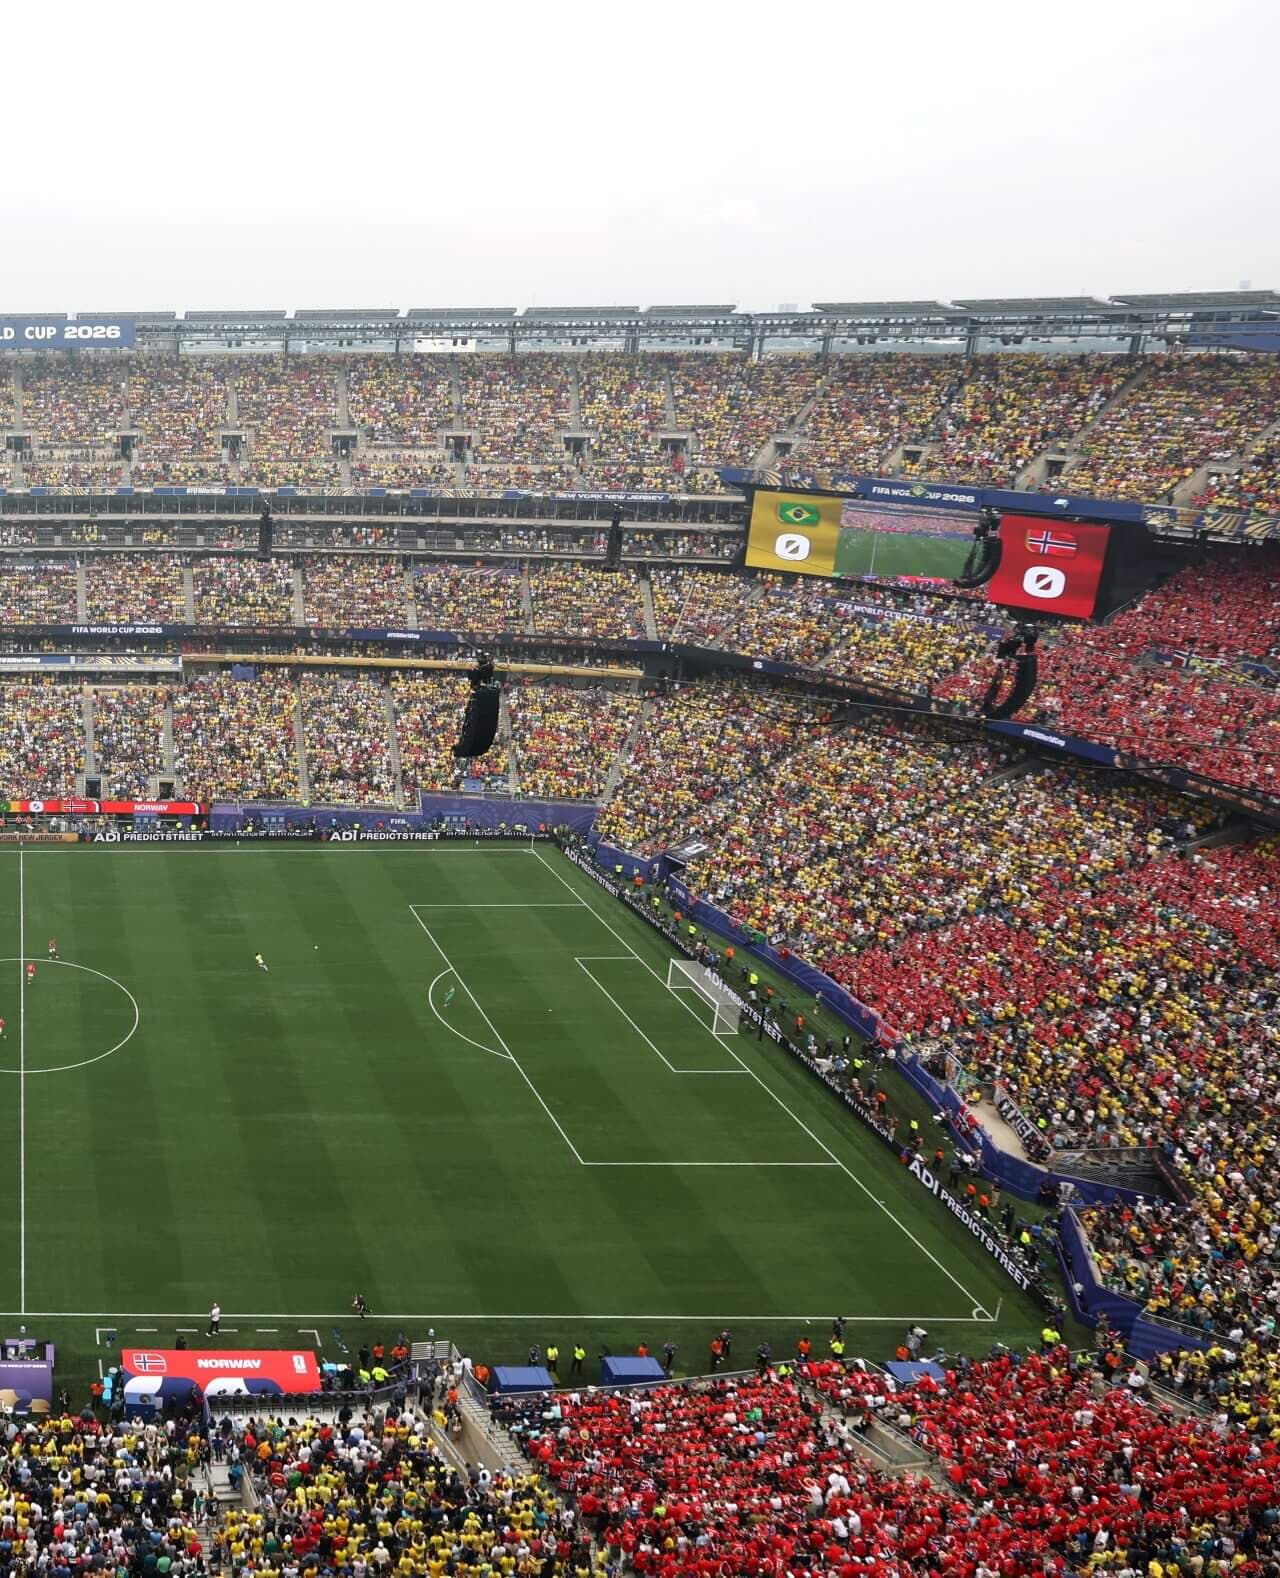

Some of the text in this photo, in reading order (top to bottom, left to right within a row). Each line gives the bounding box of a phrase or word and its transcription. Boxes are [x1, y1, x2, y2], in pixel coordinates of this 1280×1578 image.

[24, 326, 57, 339] CUP
[63, 325, 121, 339] 2026
[872, 486, 890, 494] FIFA
[942, 493, 976, 503] 2026
[134, 803, 169, 811] NORWAY
[93, 831, 121, 843] ADI
[123, 832, 204, 842] PREDICTSTREET
[330, 829, 358, 841] ADI
[360, 831, 441, 841] PREDICTSTREET
[564, 846, 620, 898] ADI PREDICTSTREET
[703, 967, 723, 987] ADI
[908, 1158, 1032, 1291] ADI PREDICTSTREET
[197, 1359, 261, 1369] NORWAY
